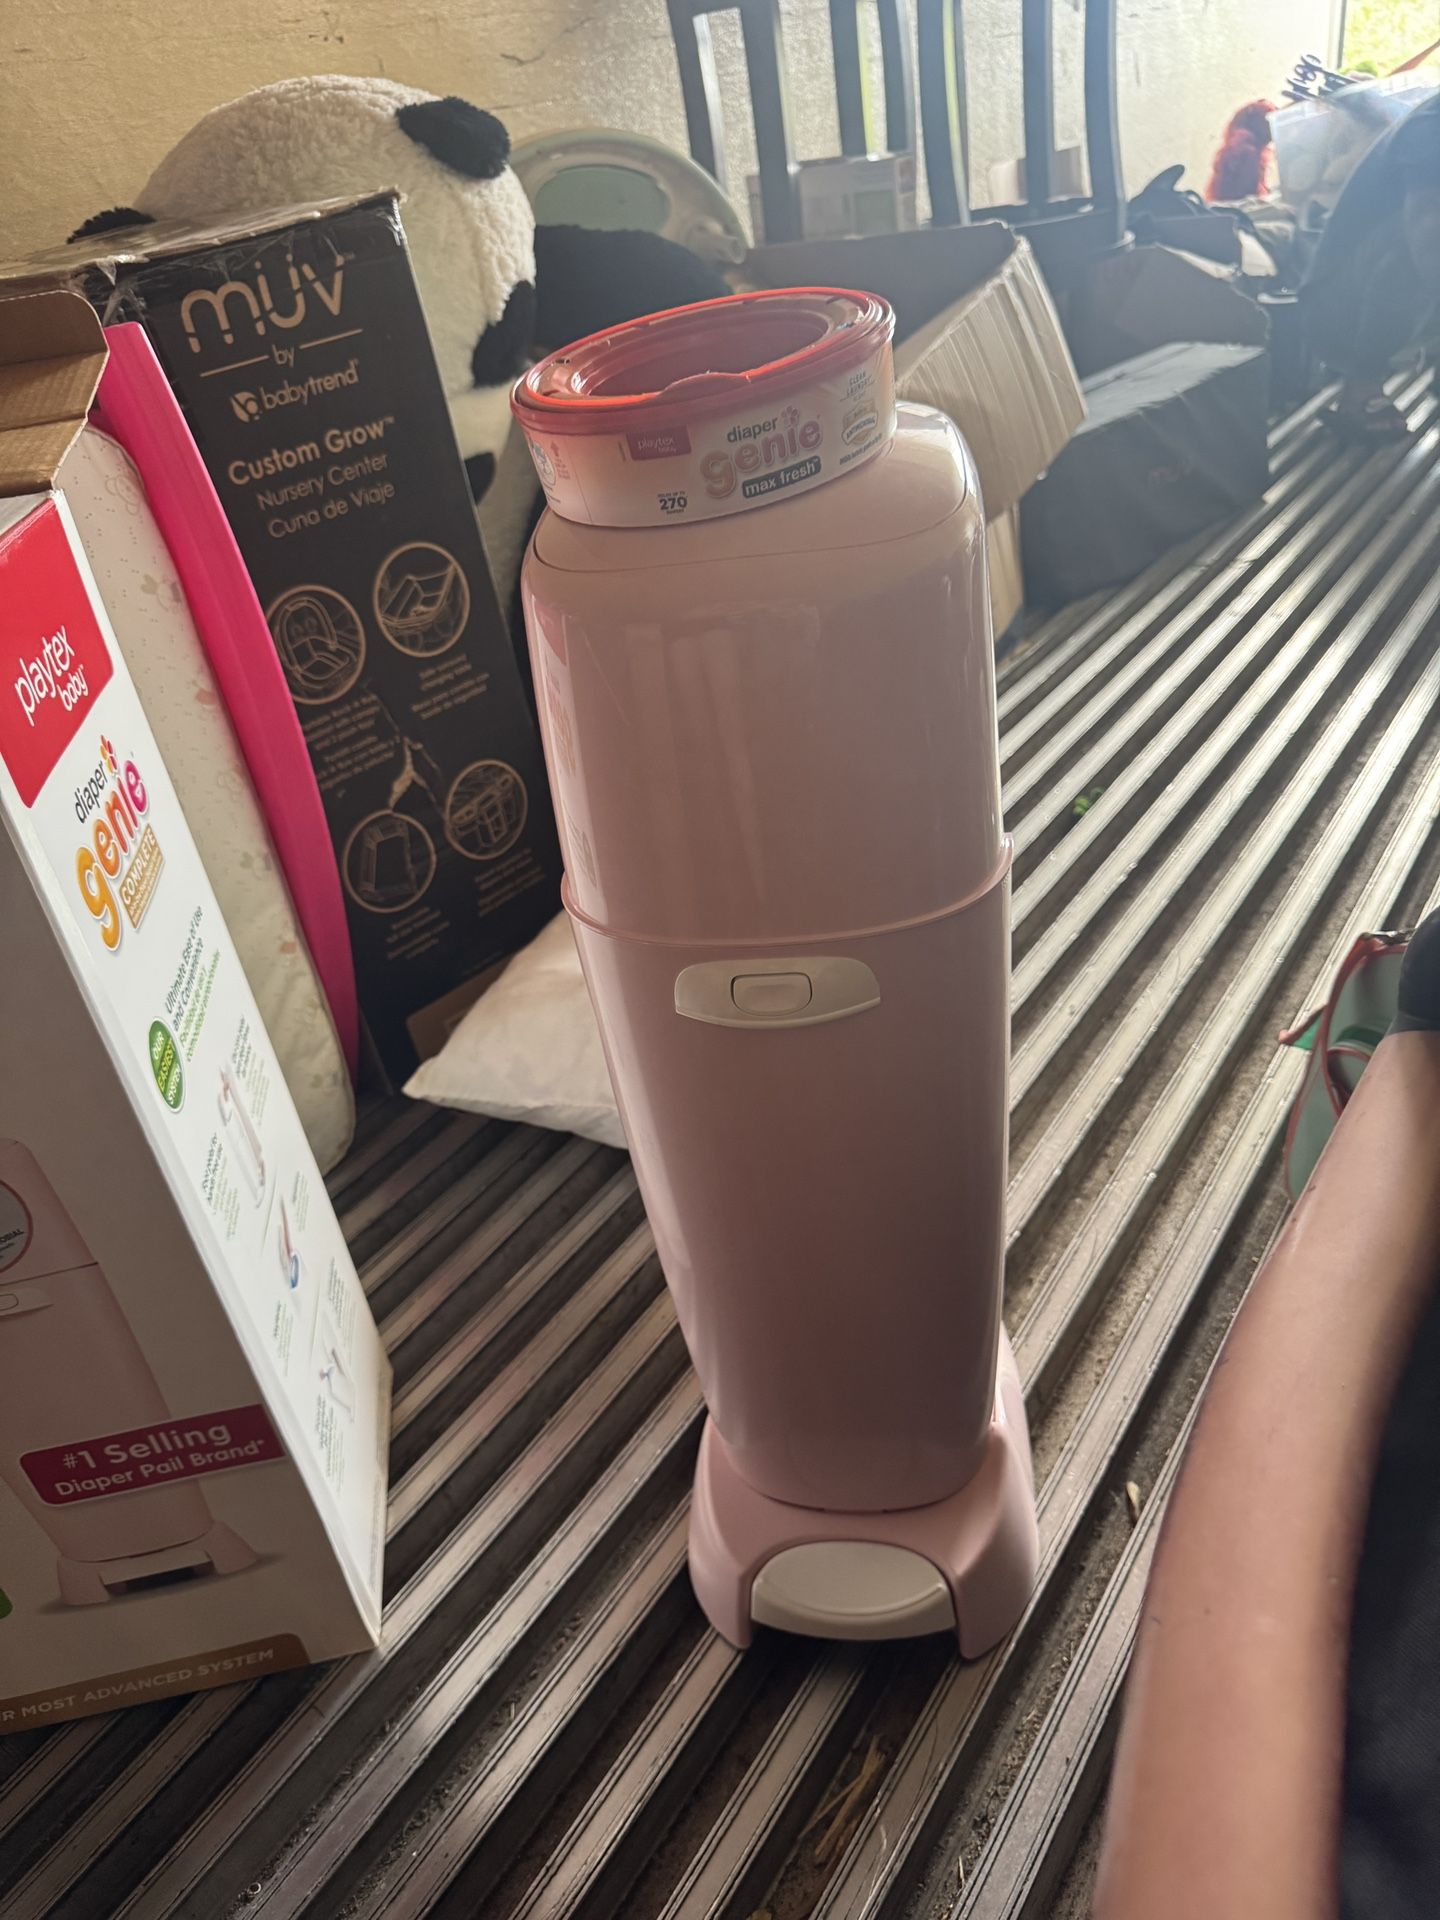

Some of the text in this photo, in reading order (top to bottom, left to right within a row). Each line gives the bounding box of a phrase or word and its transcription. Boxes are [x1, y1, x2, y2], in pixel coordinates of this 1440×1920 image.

[272, 344, 295, 368] by
[727, 417, 778, 443] diaper
[228, 441, 321, 485] Custom
[701, 412, 823, 499] genie
[256, 454, 388, 511] Nursery Center
[659, 496, 688, 511] 270
[745, 477, 777, 496] max
[268, 483, 395, 538] Cuna de Viaje
[15, 626, 75, 726] playtex
[57, 667, 89, 711] baby
[75, 762, 108, 824] diaper
[76, 752, 149, 952] genie
[121, 827, 156, 905] COMPLETE
[165, 963, 187, 1015] Ultimate
[173, 1001, 185, 1032] and
[152, 1031, 164, 1060] OUR
[63, 1425, 232, 1469] #1 Selling
[55, 1470, 134, 1496] Diaper
[140, 1456, 185, 1478] Pail
[21, 1695, 76, 1717] MOST
[84, 1669, 193, 1702] ADVANCED
[198, 1648, 274, 1676] SYSTEM
